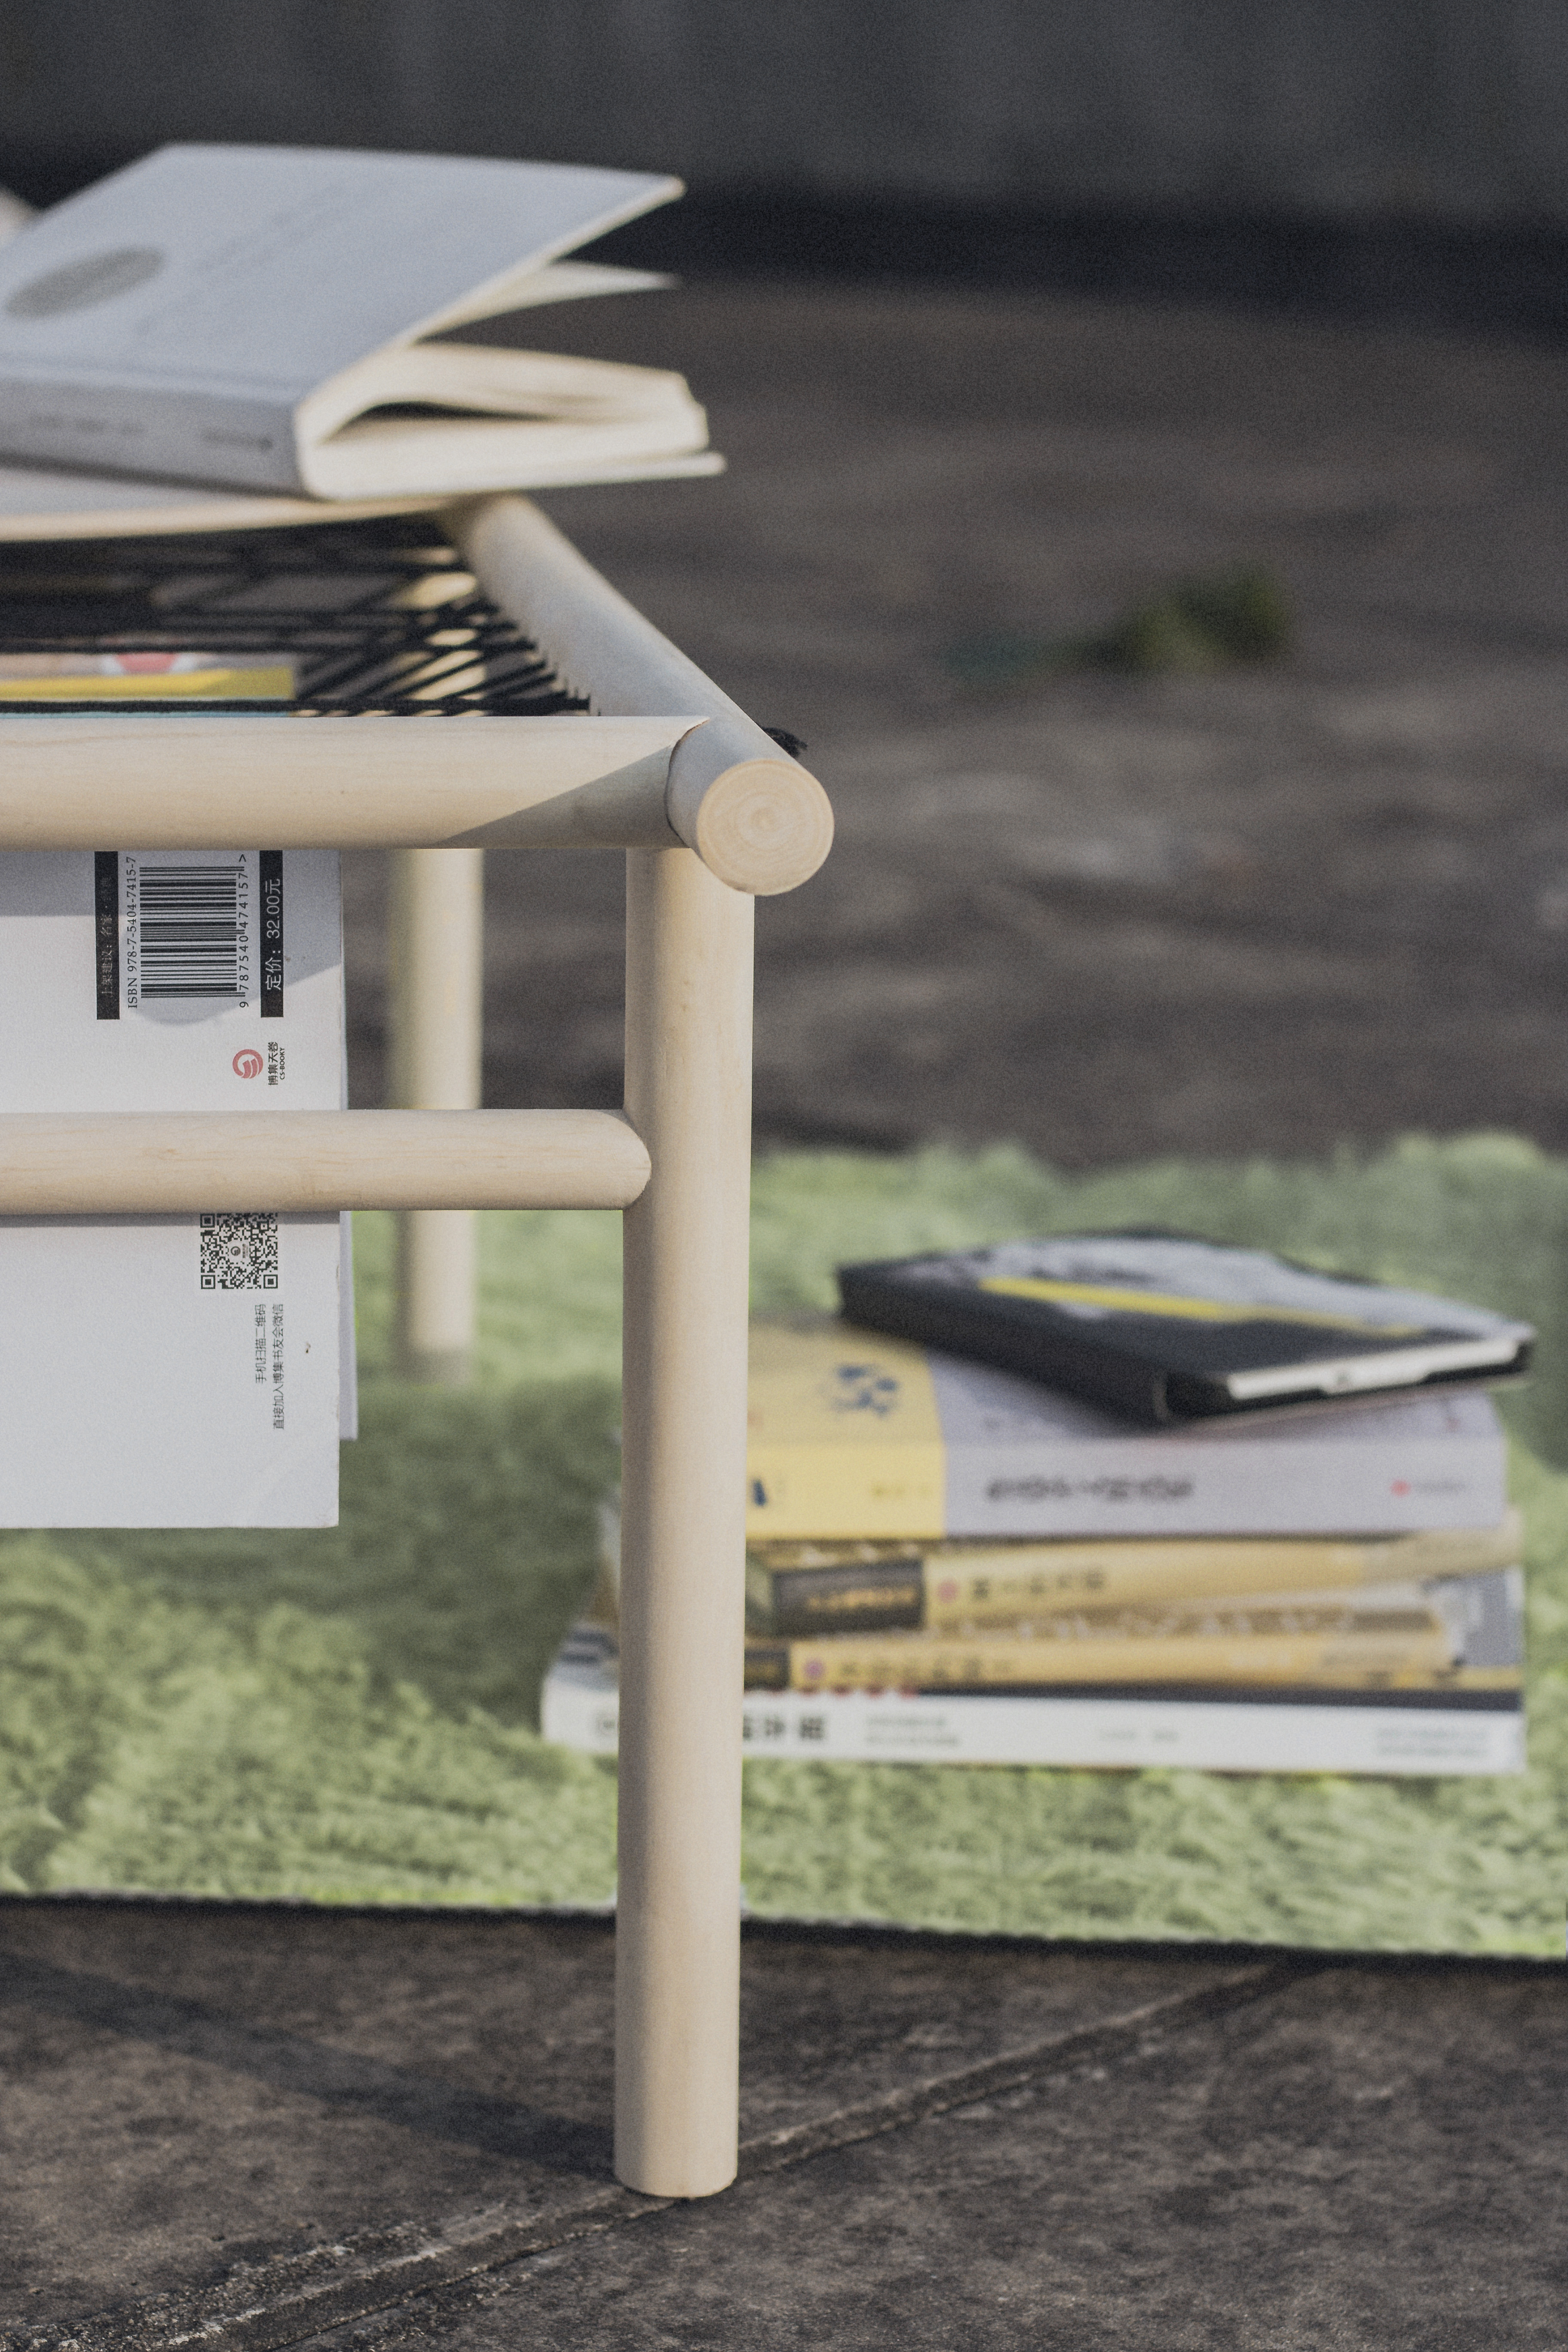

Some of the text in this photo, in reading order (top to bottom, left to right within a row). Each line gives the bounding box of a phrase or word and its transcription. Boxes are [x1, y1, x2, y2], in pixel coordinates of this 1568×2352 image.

[126, 856, 138, 1008] ISBN 978-7-5404-7415-7
[268, 1042, 278, 1085] 博集天卷
[255, 1304, 266, 1384] 手机扫描二维码
[272, 1304, 284, 1430] 直接加入博集书友会微信
